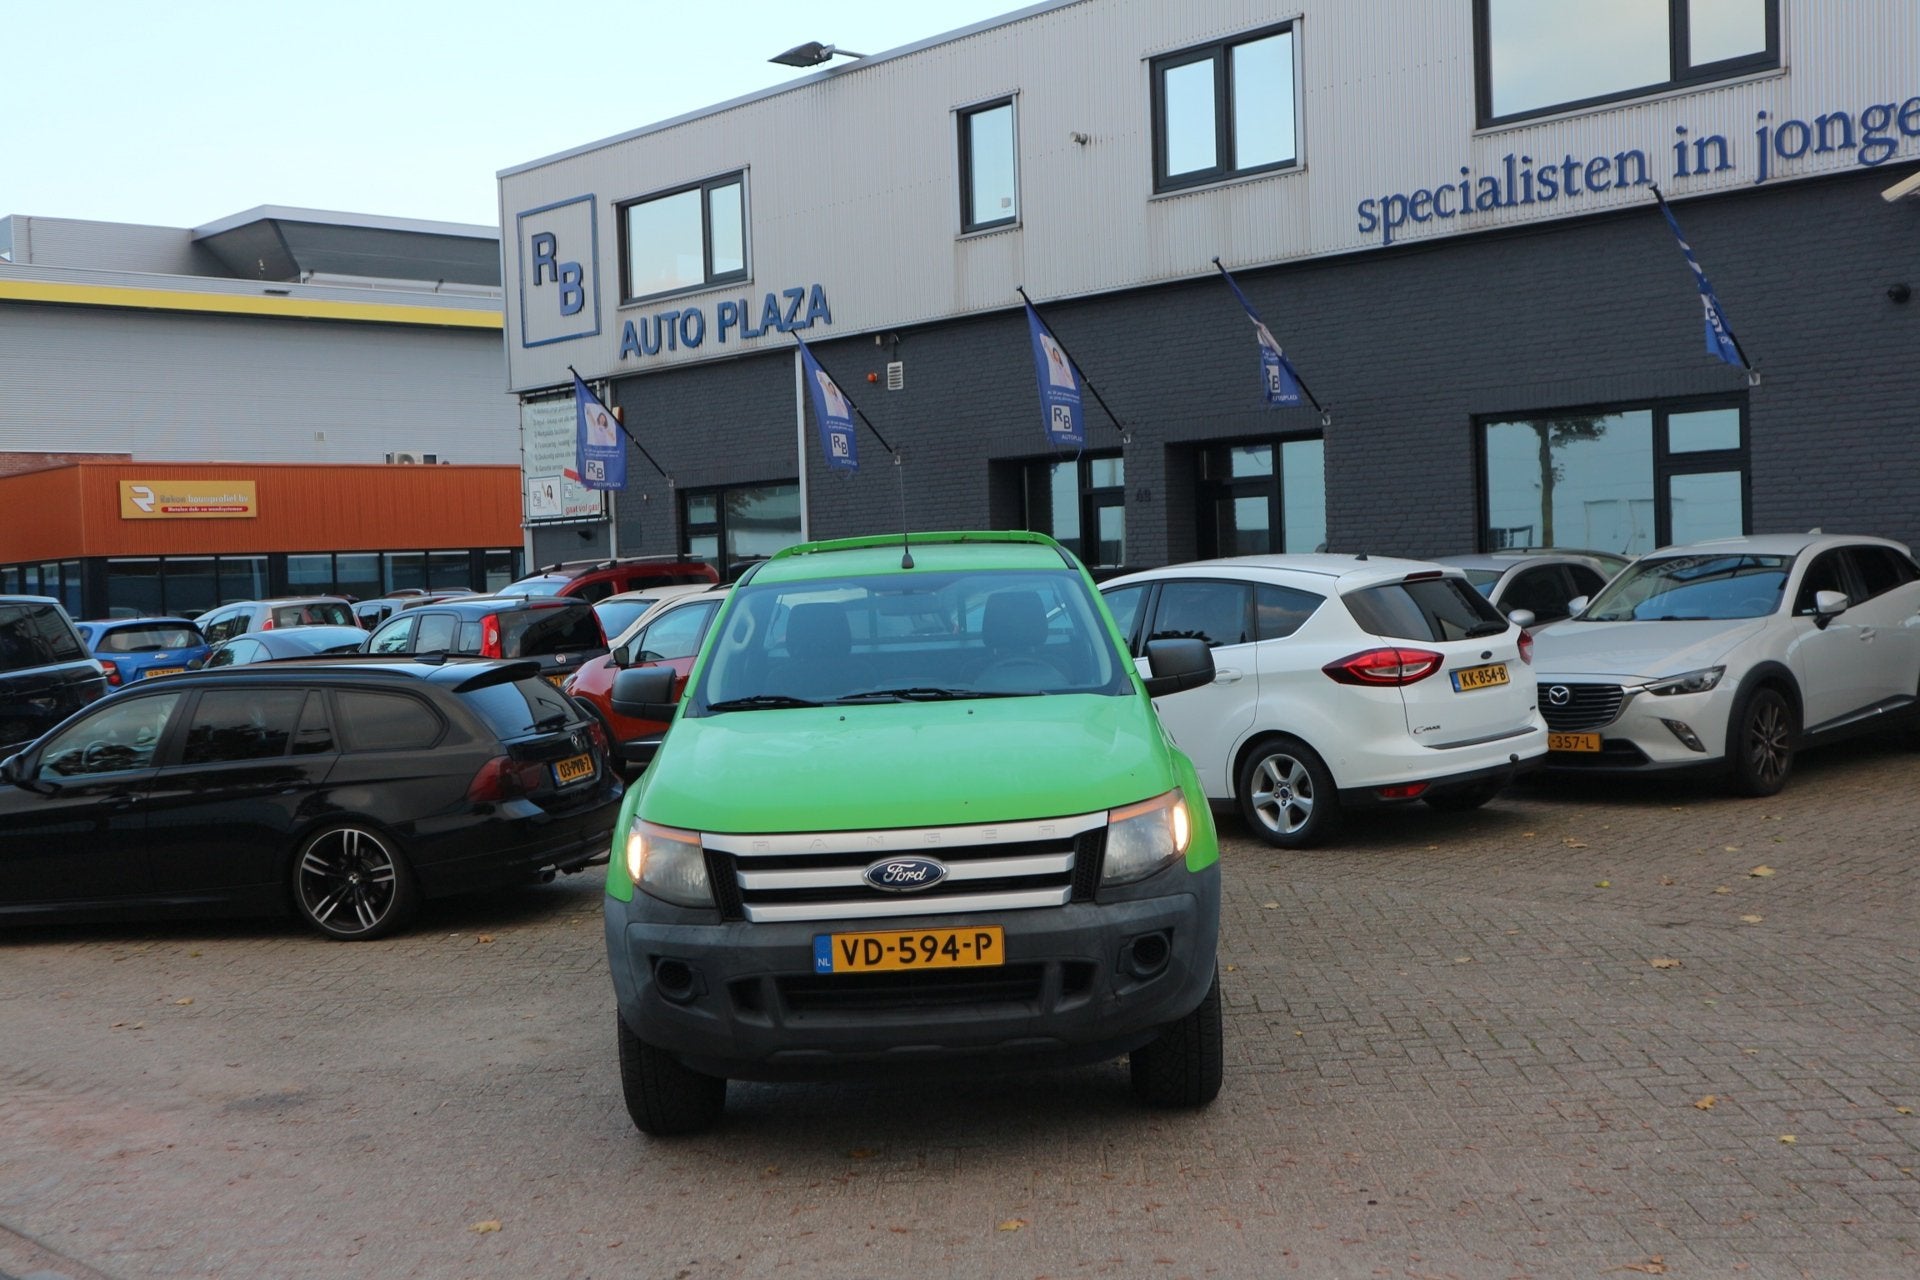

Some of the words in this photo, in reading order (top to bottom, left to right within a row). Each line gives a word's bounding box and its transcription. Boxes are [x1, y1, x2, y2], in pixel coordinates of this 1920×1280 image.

[1356, 149, 1653, 245] specialisten
[1672, 126, 1734, 178] in
[1754, 96, 1920, 185] jonge
[619, 307, 705, 360] AUTO
[717, 283, 833, 344] PLAZA
[1461, 666, 1507, 688] KK-854-B
[1548, 735, 1595, 750] -357-L
[752, 824, 1057, 852] RANGER
[883, 862, 927, 883] Ford
[840, 932, 993, 966] VD-594-P
[817, 957, 831, 967] NL
